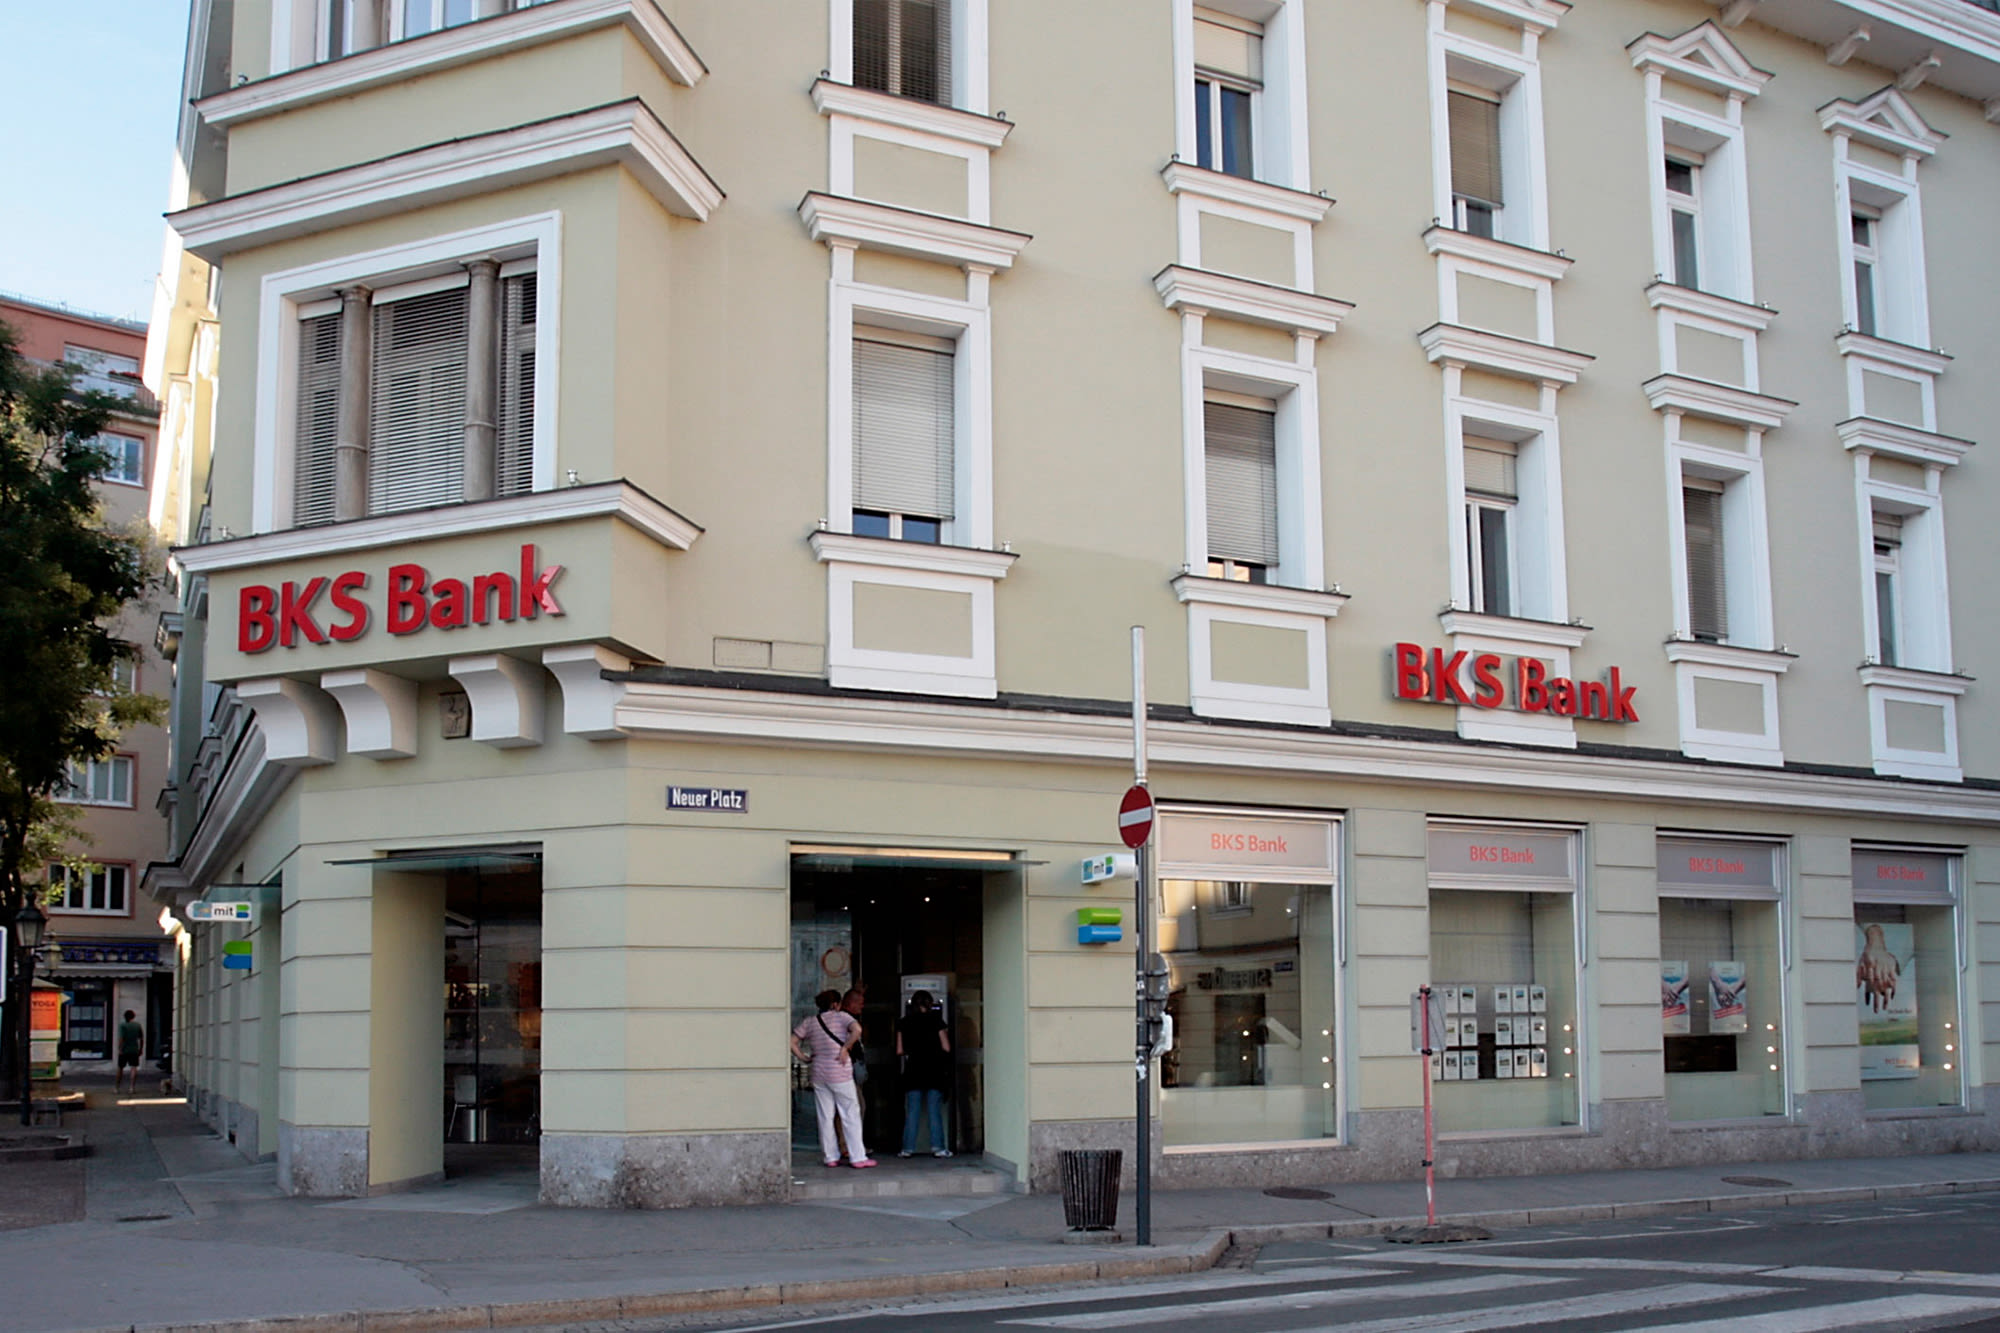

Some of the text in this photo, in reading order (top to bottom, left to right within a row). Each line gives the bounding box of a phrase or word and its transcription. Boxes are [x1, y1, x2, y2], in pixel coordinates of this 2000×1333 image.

[238, 544, 564, 652] BKS Bank
[1394, 642, 1640, 722] BKS Bank
[672, 787, 742, 808] Neuer Platz
[1210, 833, 1287, 853] BKS Bank
[1470, 845, 1535, 864] BKS Bank
[1689, 856, 1744, 873] BKS Bank
[213, 906, 234, 917] mit
